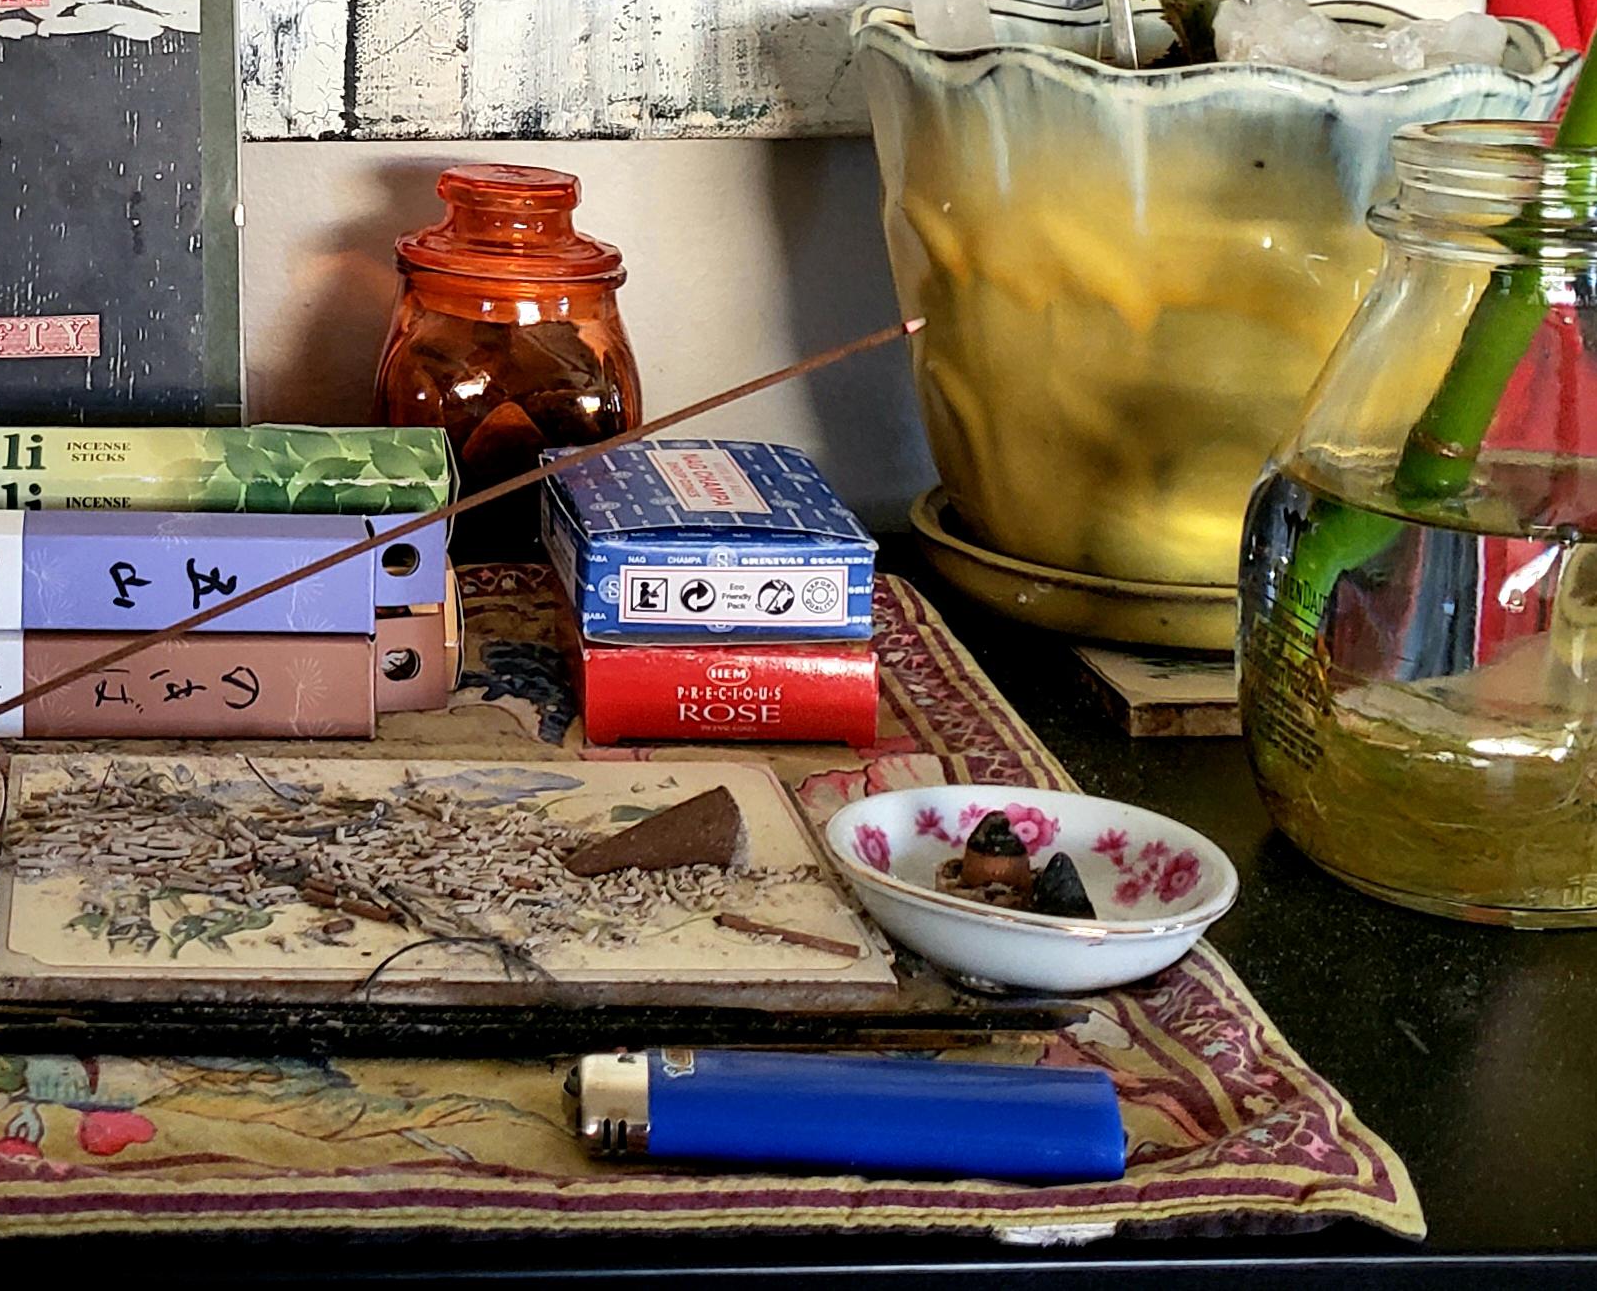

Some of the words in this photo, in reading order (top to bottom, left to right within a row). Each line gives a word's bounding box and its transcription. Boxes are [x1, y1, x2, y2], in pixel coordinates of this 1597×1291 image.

[66, 442, 132, 451] INCENSE
[71, 453, 125, 462] STICKS
[65, 496, 132, 509] INCENSE
[628, 556, 647, 564] NAG
[667, 556, 703, 565] CHAMPA
[730, 583, 745, 591] Eco
[806, 580, 835, 593] EXPORT
[722, 593, 751, 602] Friendly
[727, 602, 746, 610] Pack
[805, 597, 835, 611] QUALITY
[710, 668, 747, 679] HEM
[678, 702, 781, 723] ROSE
